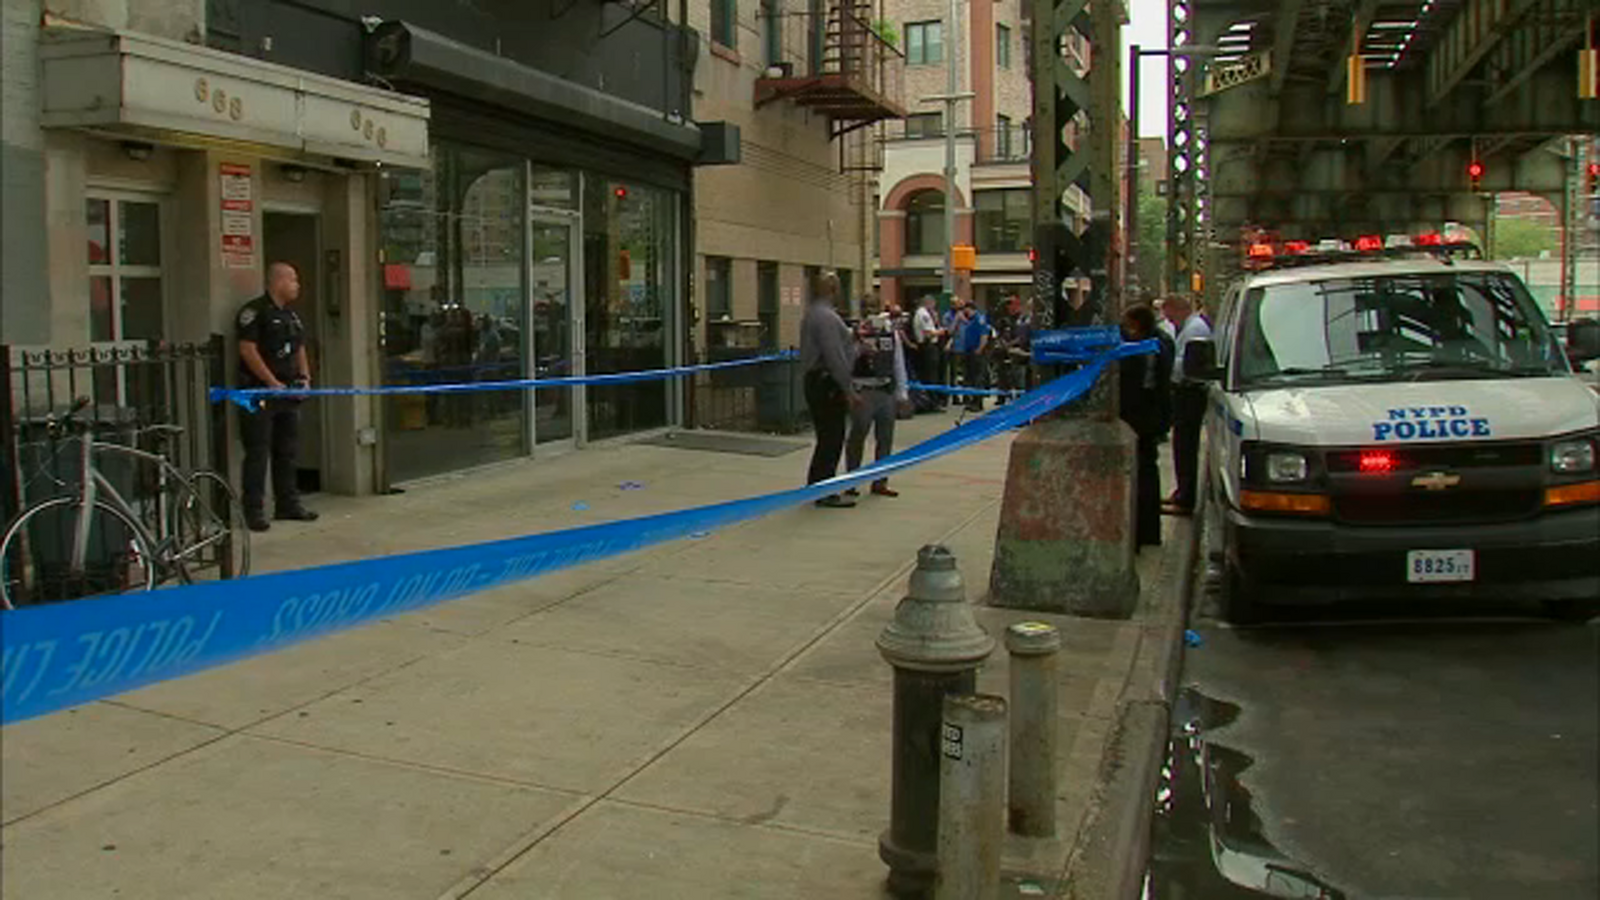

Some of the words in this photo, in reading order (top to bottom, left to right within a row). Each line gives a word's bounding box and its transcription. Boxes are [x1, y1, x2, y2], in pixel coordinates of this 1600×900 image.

[1373, 417, 1491, 440] POLICE
[1387, 406, 1467, 420] NYPD
[1414, 557, 1455, 573] 8825
[258, 582, 380, 643] CROSS
[1, 638, 60, 705] LI
[47, 611, 223, 697] POLICE
